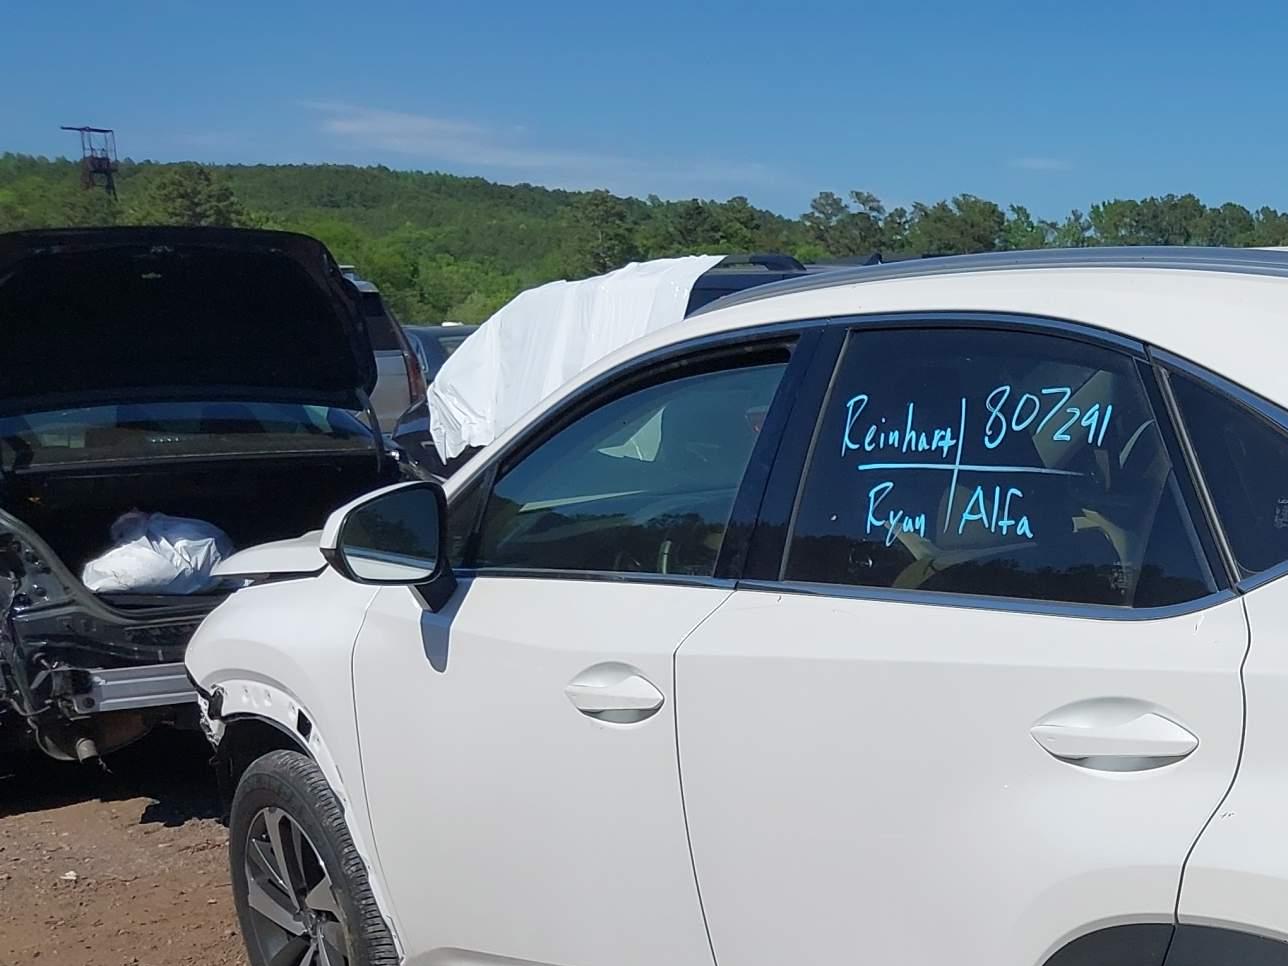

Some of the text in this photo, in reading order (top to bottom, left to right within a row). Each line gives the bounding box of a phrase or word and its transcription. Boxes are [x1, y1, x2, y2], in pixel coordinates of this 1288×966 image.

[984, 385, 1113, 450] 807291
[865, 481, 1034, 547] Ryan Alfa
